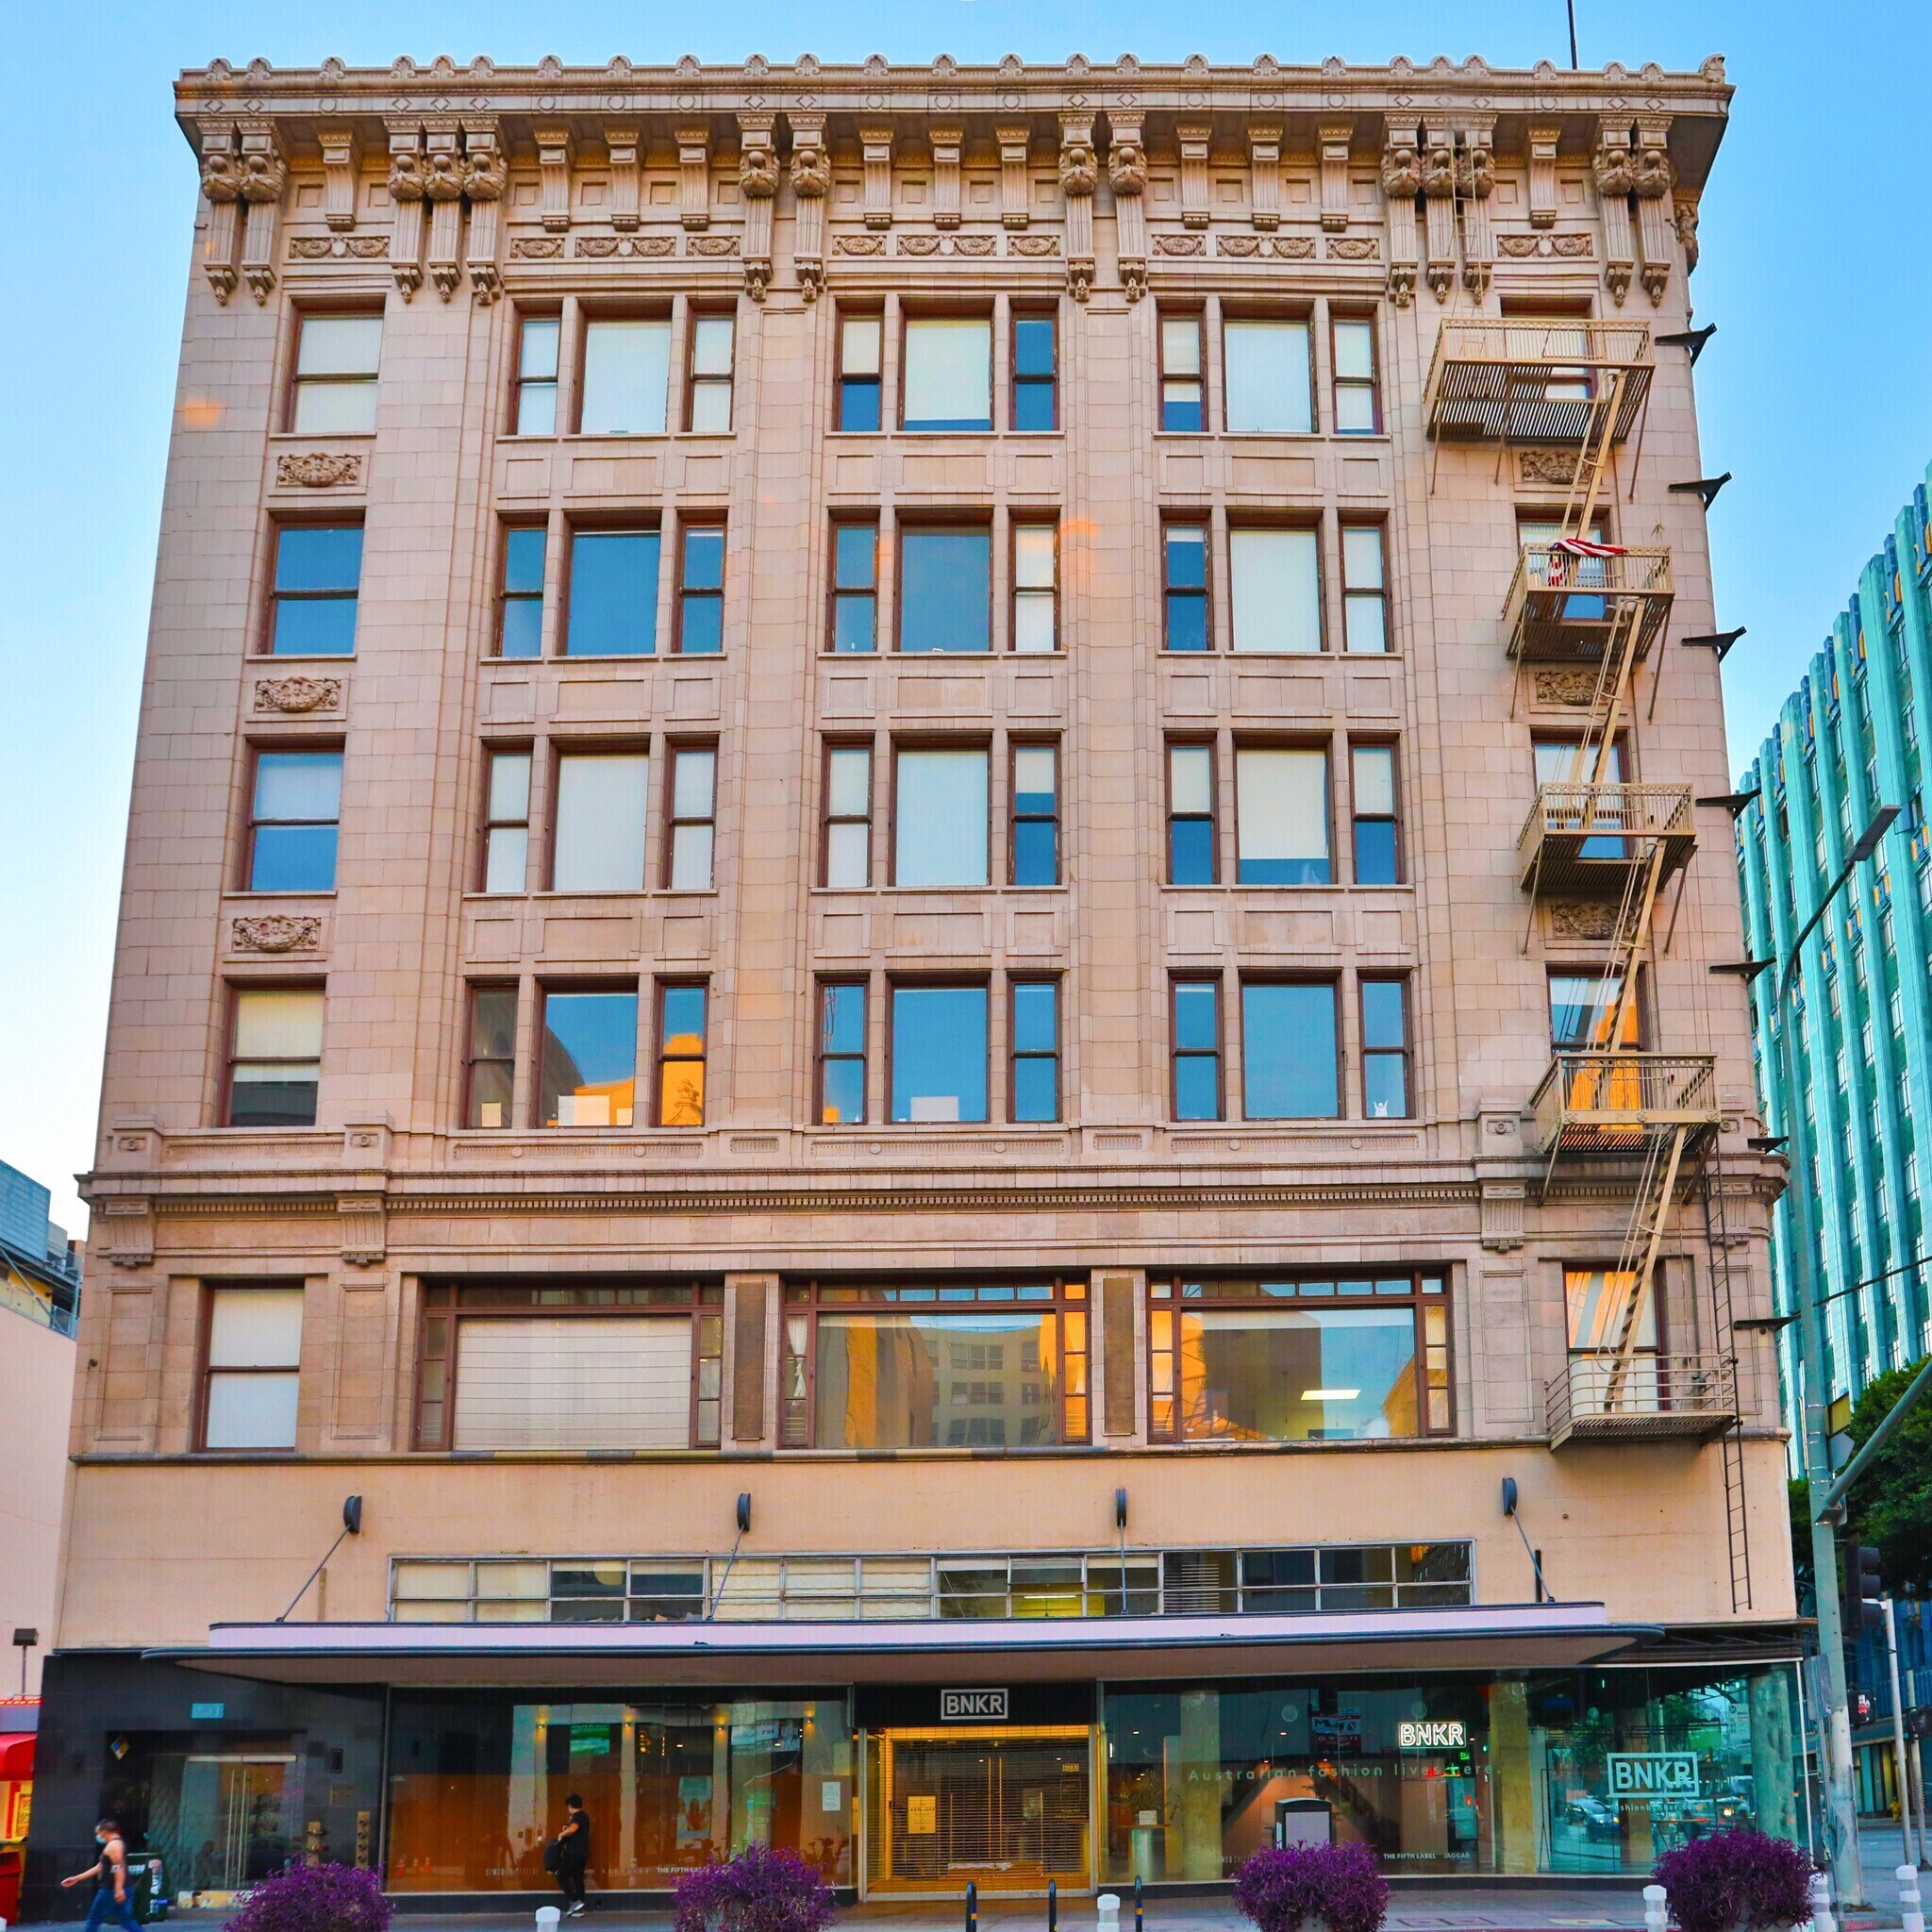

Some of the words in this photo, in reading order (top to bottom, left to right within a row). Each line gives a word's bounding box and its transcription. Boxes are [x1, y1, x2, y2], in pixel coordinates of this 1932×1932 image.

[946, 1694, 1004, 1714] BNKR
[1400, 1723, 1464, 1747] BNKR
[1189, 1768, 1296, 1781] Australian
[1307, 1764, 1383, 1778] fashion
[1615, 1761, 1693, 1790] BNKR
